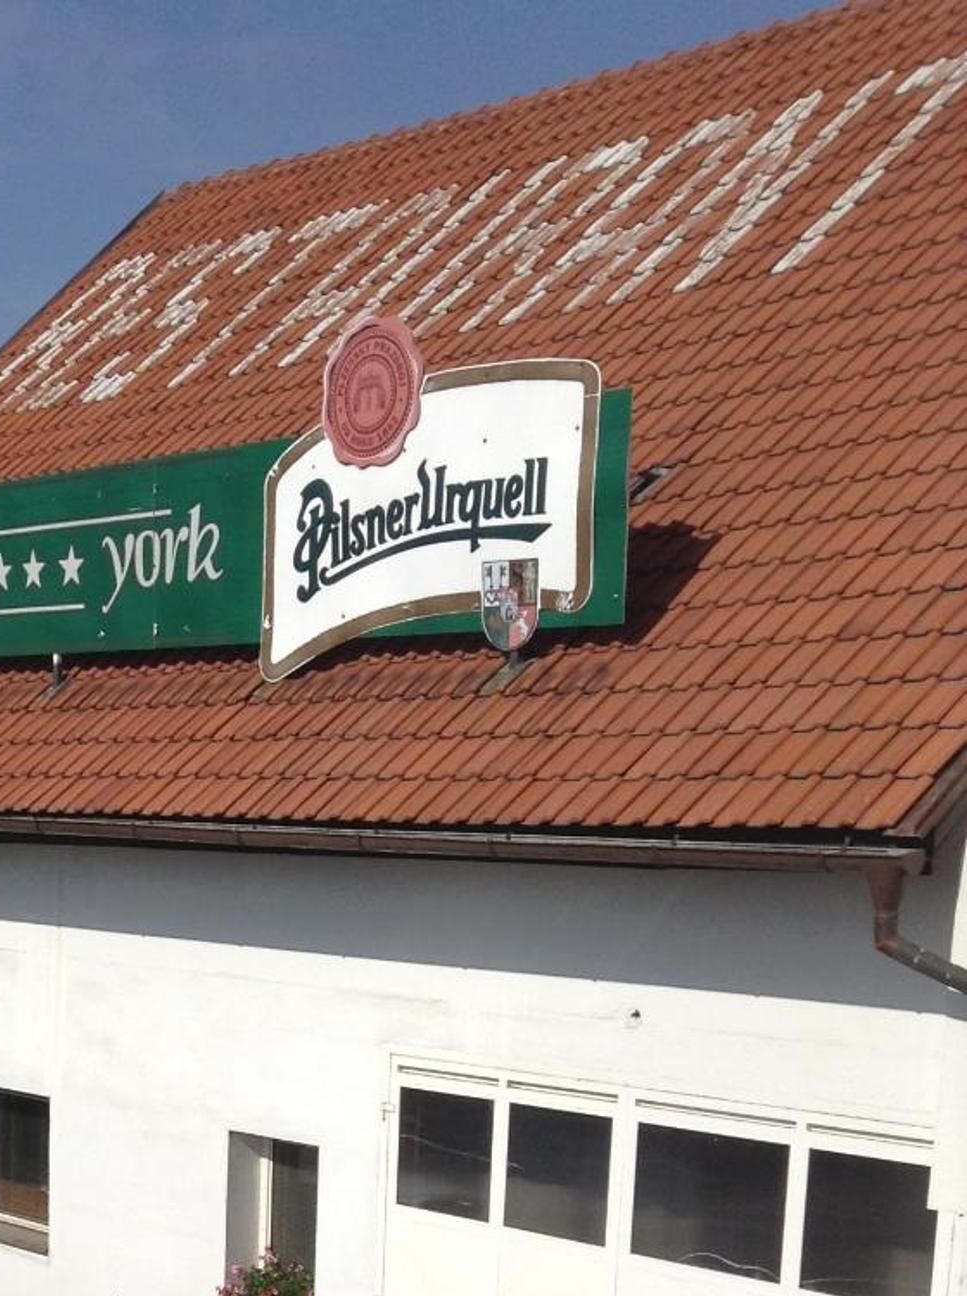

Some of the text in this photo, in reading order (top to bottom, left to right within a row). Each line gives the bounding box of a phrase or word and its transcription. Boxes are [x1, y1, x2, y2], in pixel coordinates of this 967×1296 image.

[102, 503, 223, 614] york
[293, 457, 549, 603] Pilsner Urquell
